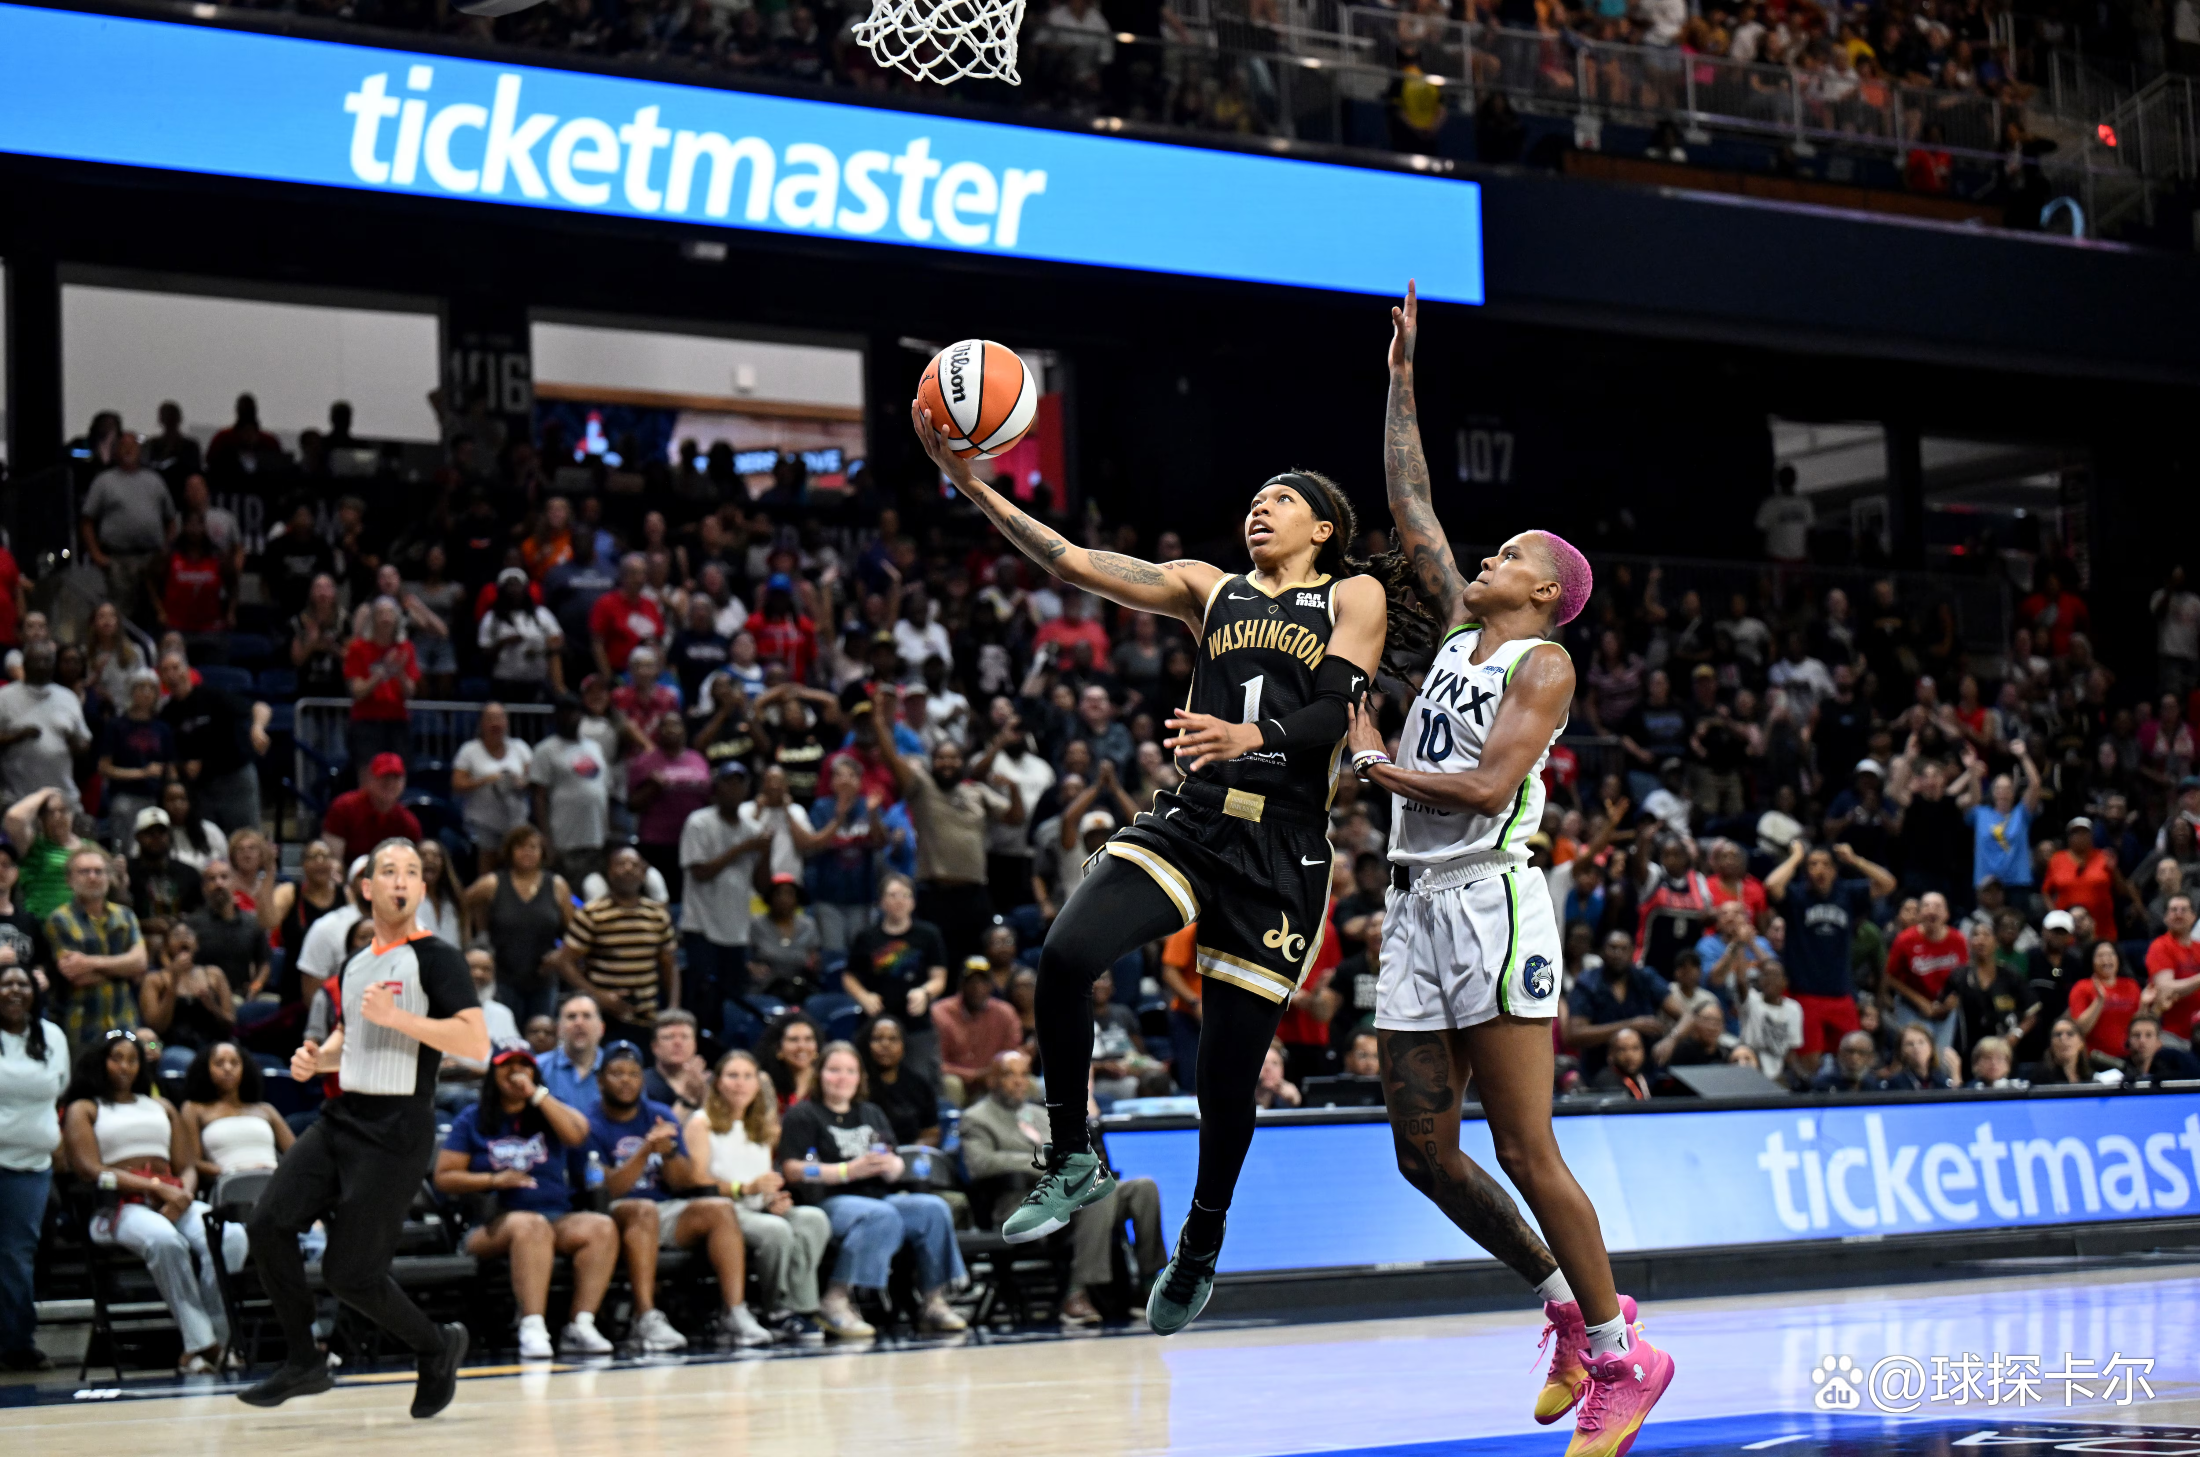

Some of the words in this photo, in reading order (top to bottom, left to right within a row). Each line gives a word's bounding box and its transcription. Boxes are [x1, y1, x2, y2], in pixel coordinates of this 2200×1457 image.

[345, 66, 1047, 247] ticketmaster
[1457, 429, 1515, 483] 107
[1296, 592, 1321, 600] CAR
[1296, 599, 1326, 609] max
[1208, 619, 1326, 671] WASHINGTON
[1240, 674, 1264, 723] 1
[1416, 708, 1454, 762] 10
